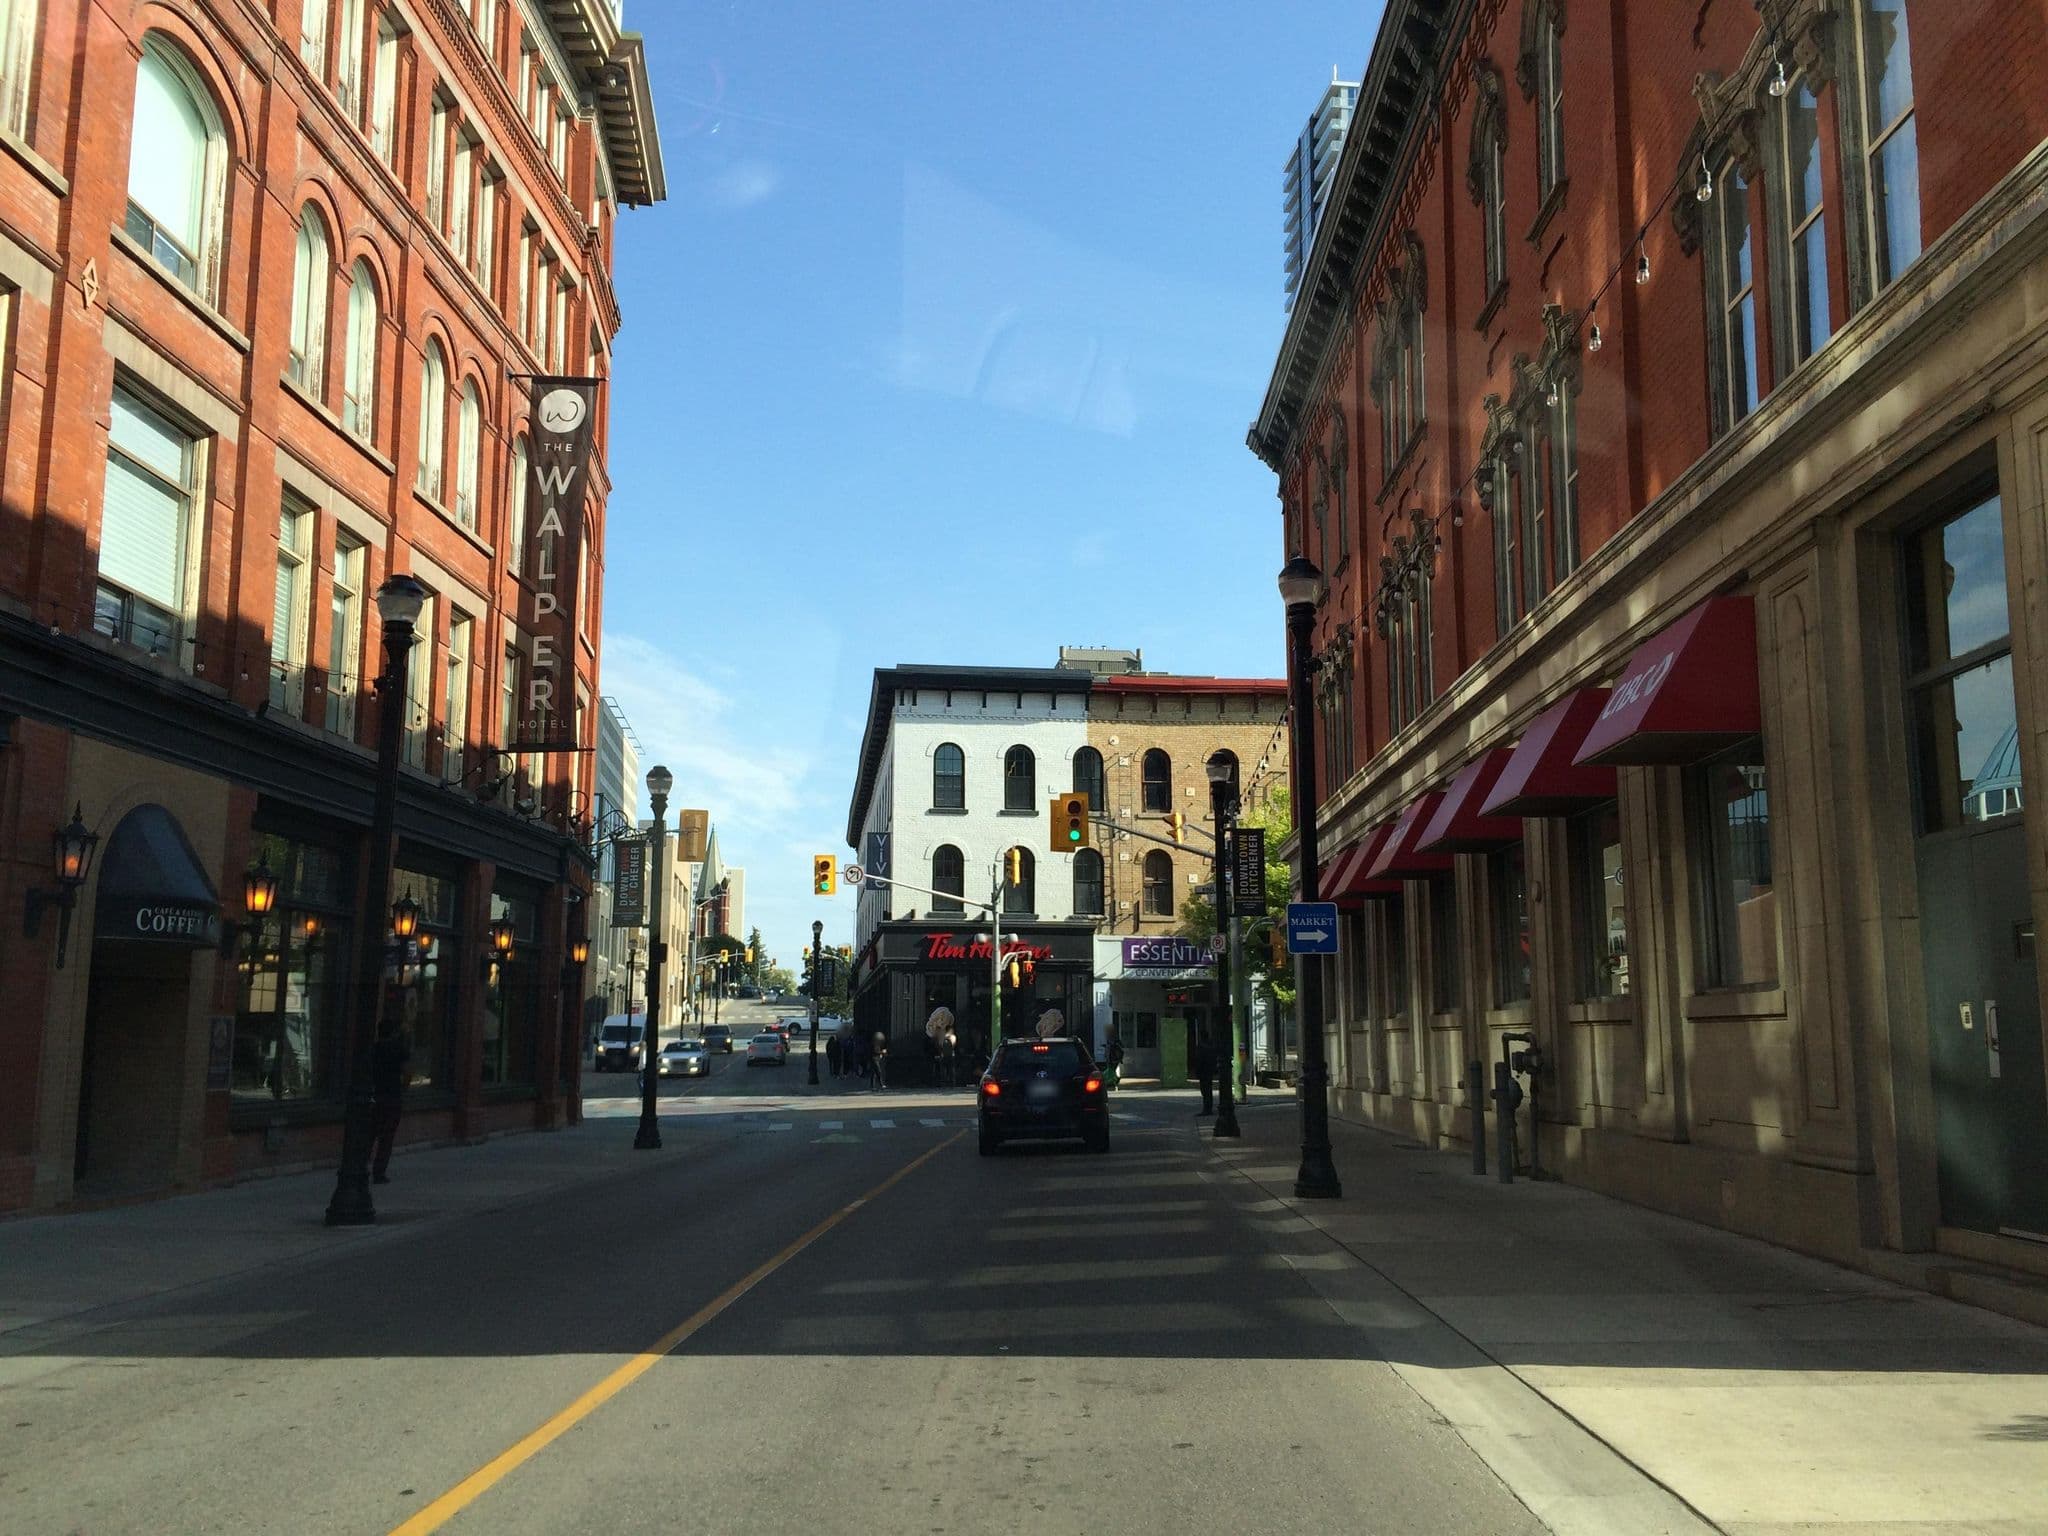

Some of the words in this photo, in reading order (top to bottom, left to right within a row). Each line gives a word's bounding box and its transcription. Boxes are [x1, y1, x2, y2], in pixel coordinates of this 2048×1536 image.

[543, 443, 573, 452] THE
[528, 465, 577, 712] WALPER
[518, 719, 568, 729] HOTEL
[1239, 835, 1249, 895] DOWNTOWN
[1248, 835, 1259, 895] KITCHENER
[1290, 917, 1335, 926] MARKET
[927, 933, 966, 959] Tim
